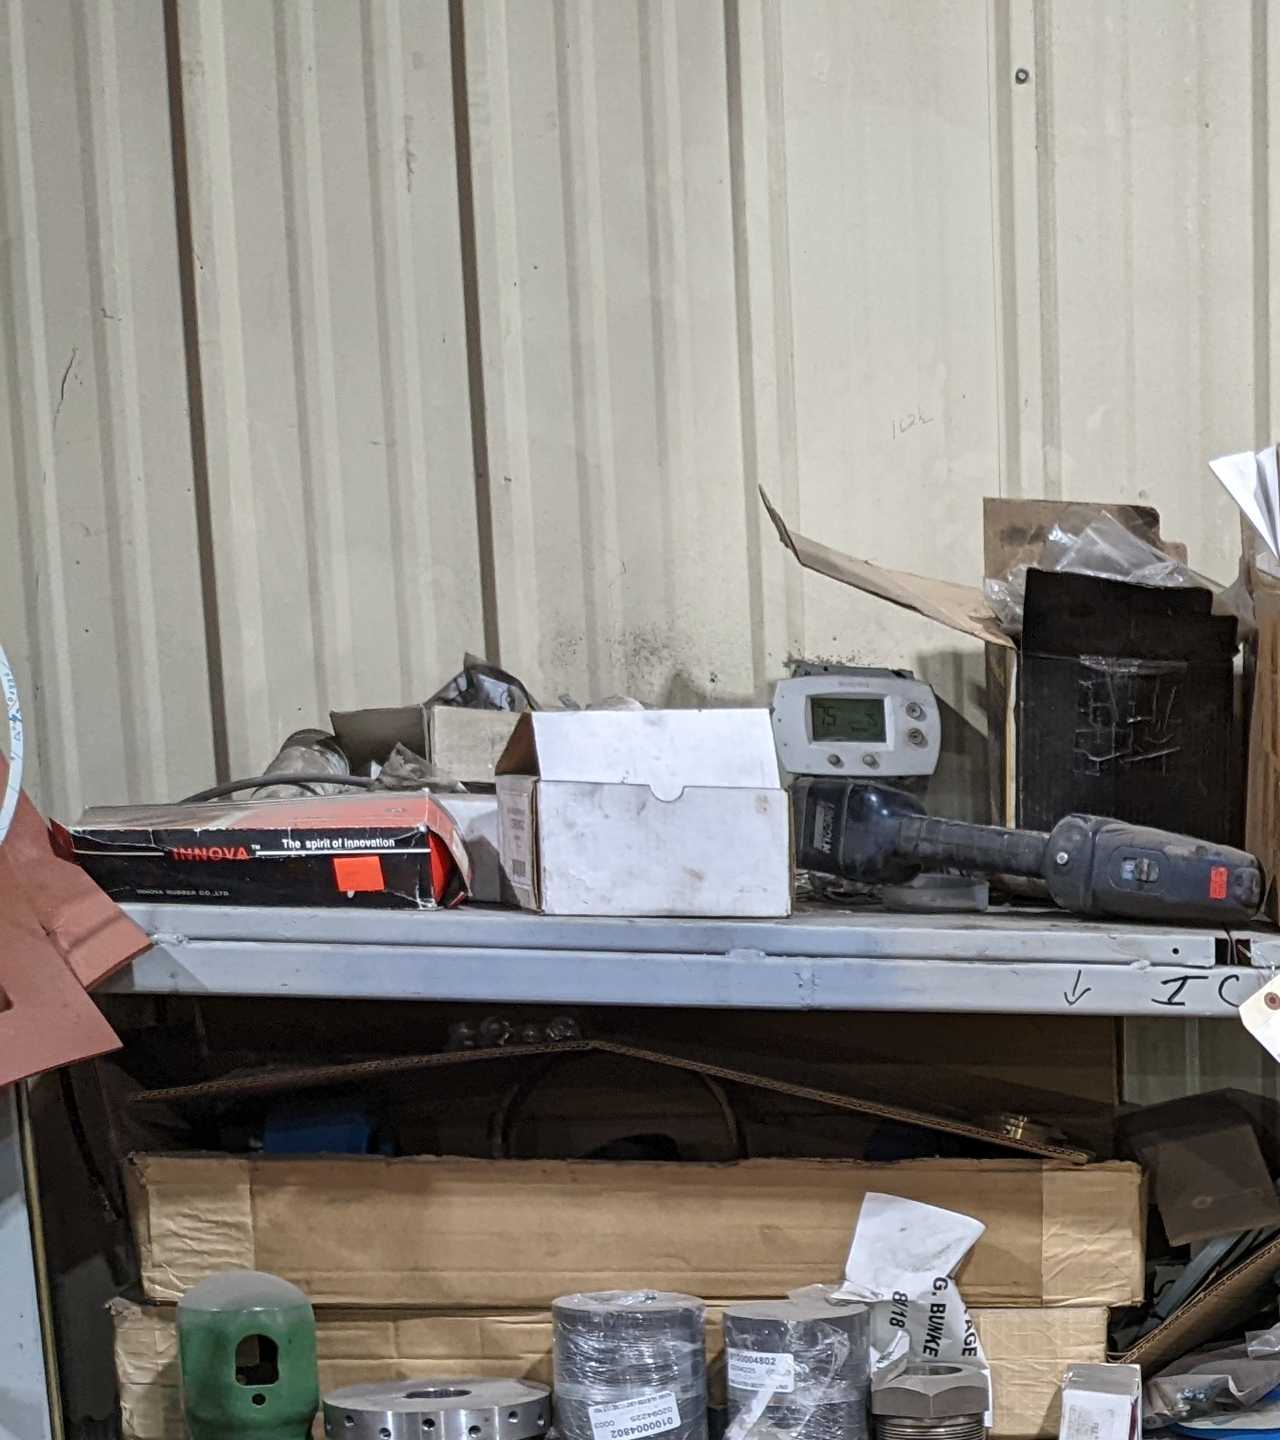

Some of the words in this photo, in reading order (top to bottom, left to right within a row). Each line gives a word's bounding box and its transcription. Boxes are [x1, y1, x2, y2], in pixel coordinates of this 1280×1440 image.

[281, 838, 301, 849] The
[305, 837, 330, 850] spirit
[332, 837, 342, 848] of
[344, 837, 396, 849] innovation
[171, 847, 249, 861] INNOVA
[923, 1303, 947, 1358] BUNKE
[611, 1417, 674, 1439] 0100004802
